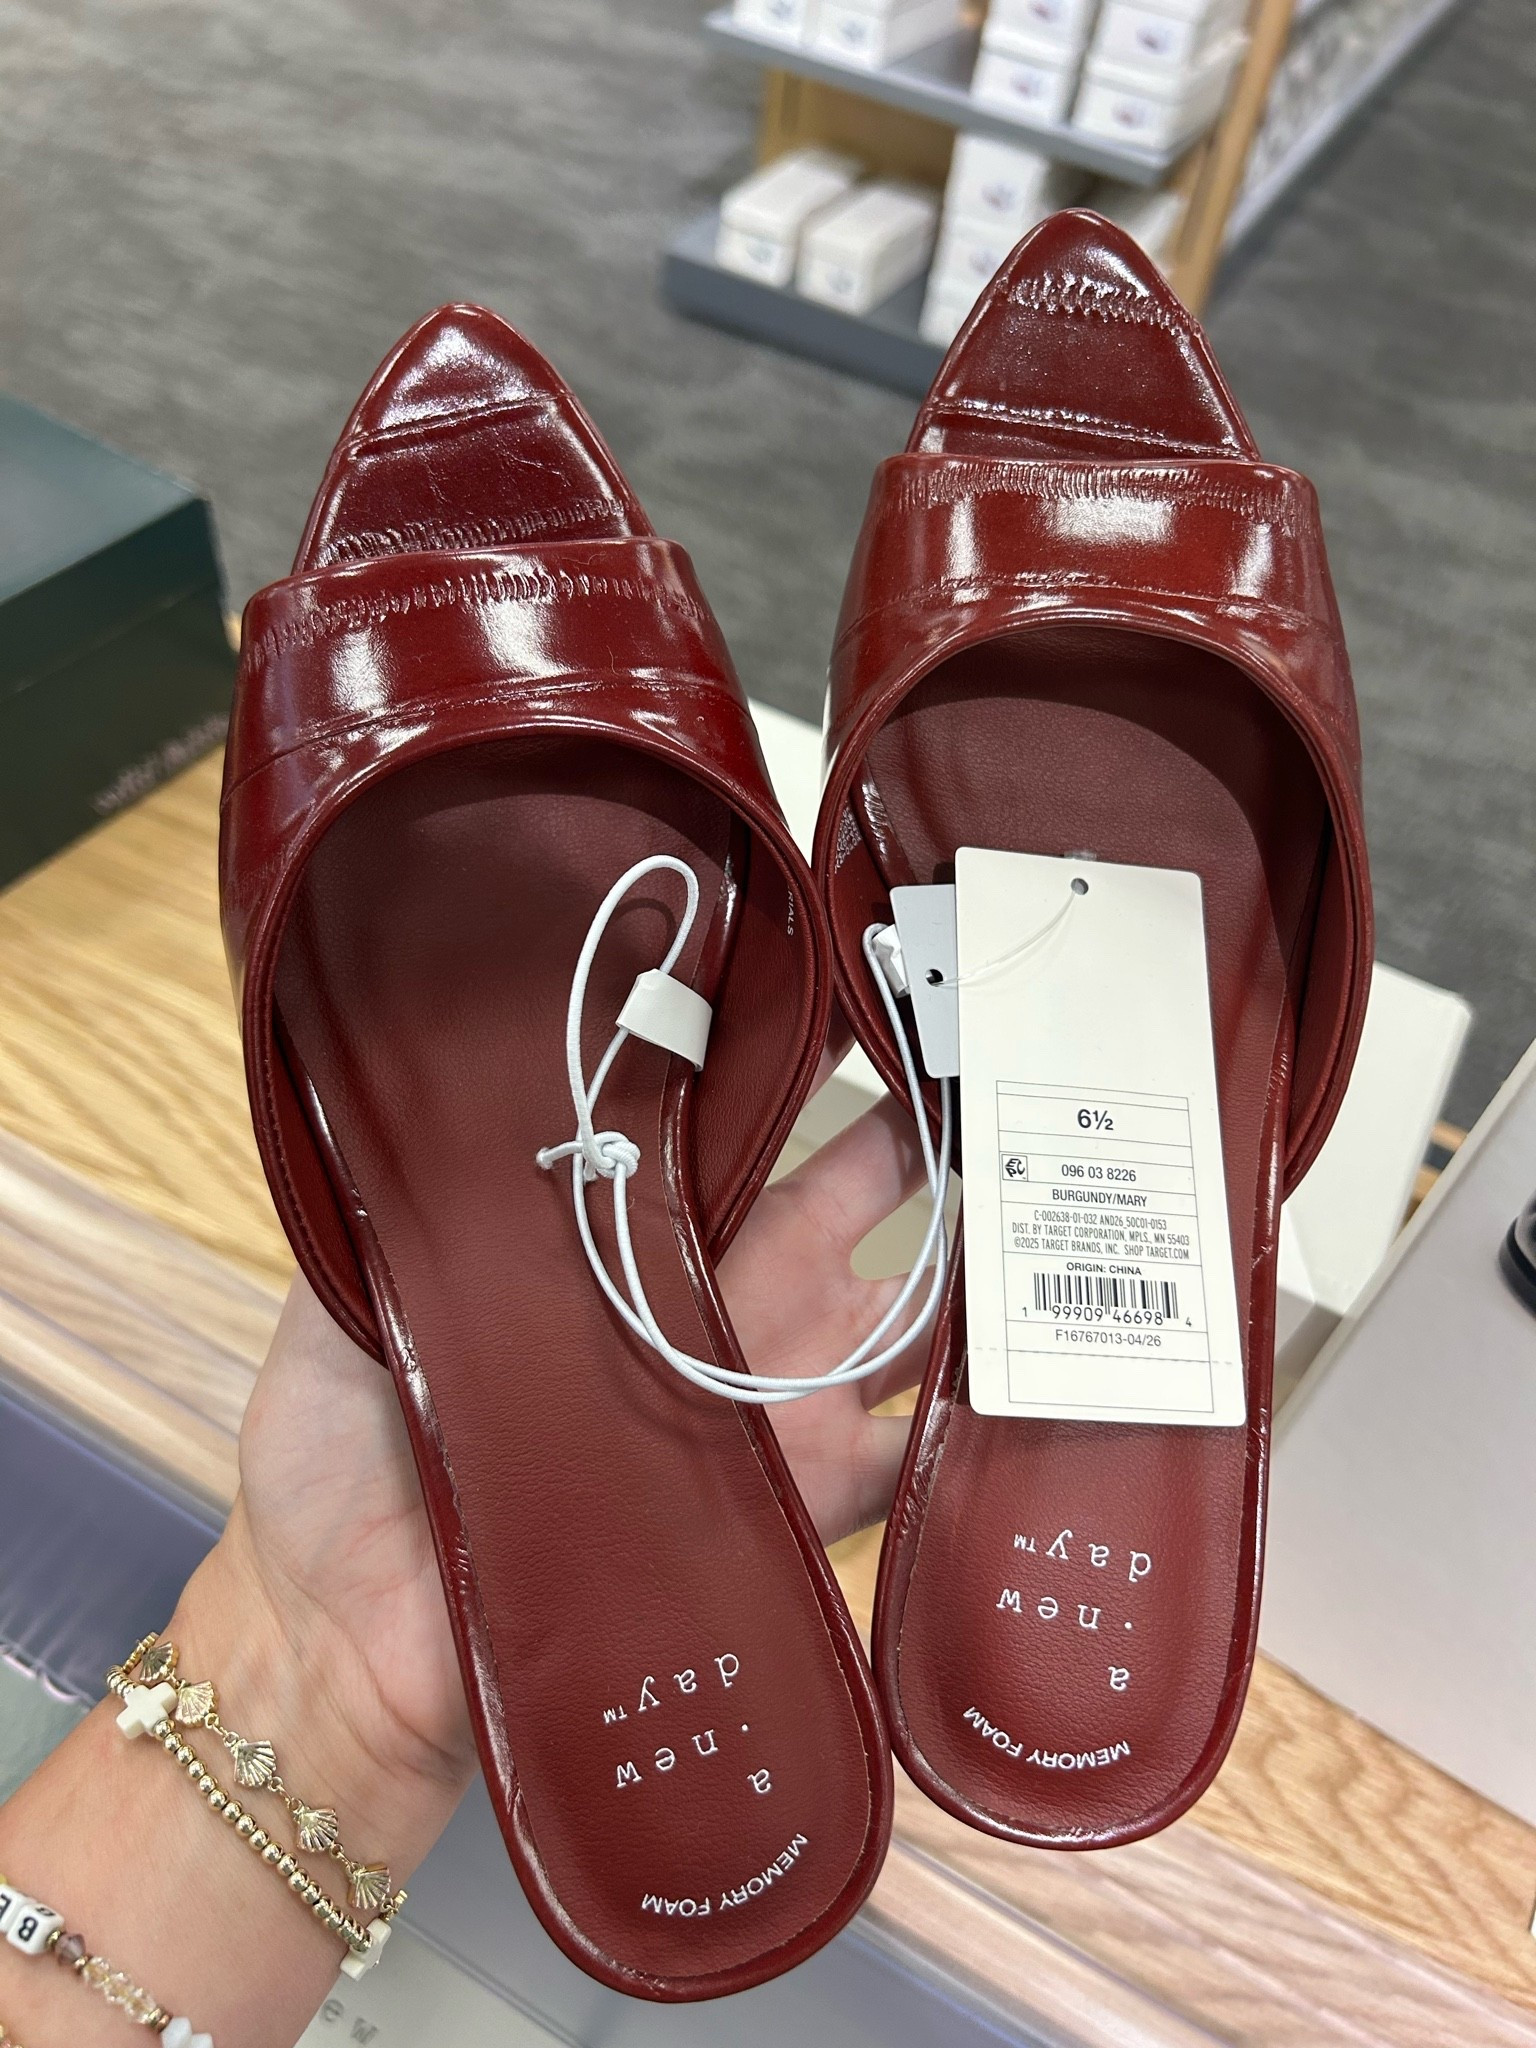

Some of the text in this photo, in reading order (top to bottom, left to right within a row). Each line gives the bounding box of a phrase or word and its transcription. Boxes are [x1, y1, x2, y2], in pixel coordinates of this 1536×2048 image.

[1061, 1164, 1137, 1182] 096 03 8226
[1052, 1188, 1147, 1208] BURGUNDY/MARY
[1034, 1209, 1098, 1225] C-002638-01-032
[1012, 1221, 1031, 1235] DIST.
[1033, 1223, 1042, 1235] BY
[1044, 1224, 1072, 1237] TARGET
[1074, 1226, 1127, 1242] CORPORATION,
[1154, 1232, 1166, 1244] MN
[1167, 1233, 1190, 1246] 55403
[1014, 1236, 1190, 1260] ©2025 TARGET BRANDS, INC. SHOP TARGET.COM
[1066, 1262, 1142, 1276] ORIGIN: CHINA
[1022, 1305, 1192, 1328] 1 99909 46698 4
[1055, 1328, 1162, 1347] F16767013-04/26
[1108, 1666, 1130, 1691] a
[963, 1705, 1131, 1769] MEMORY FOAM
[747, 1768, 772, 1794] a
[641, 1833, 809, 1916] MEMORY FOAM
